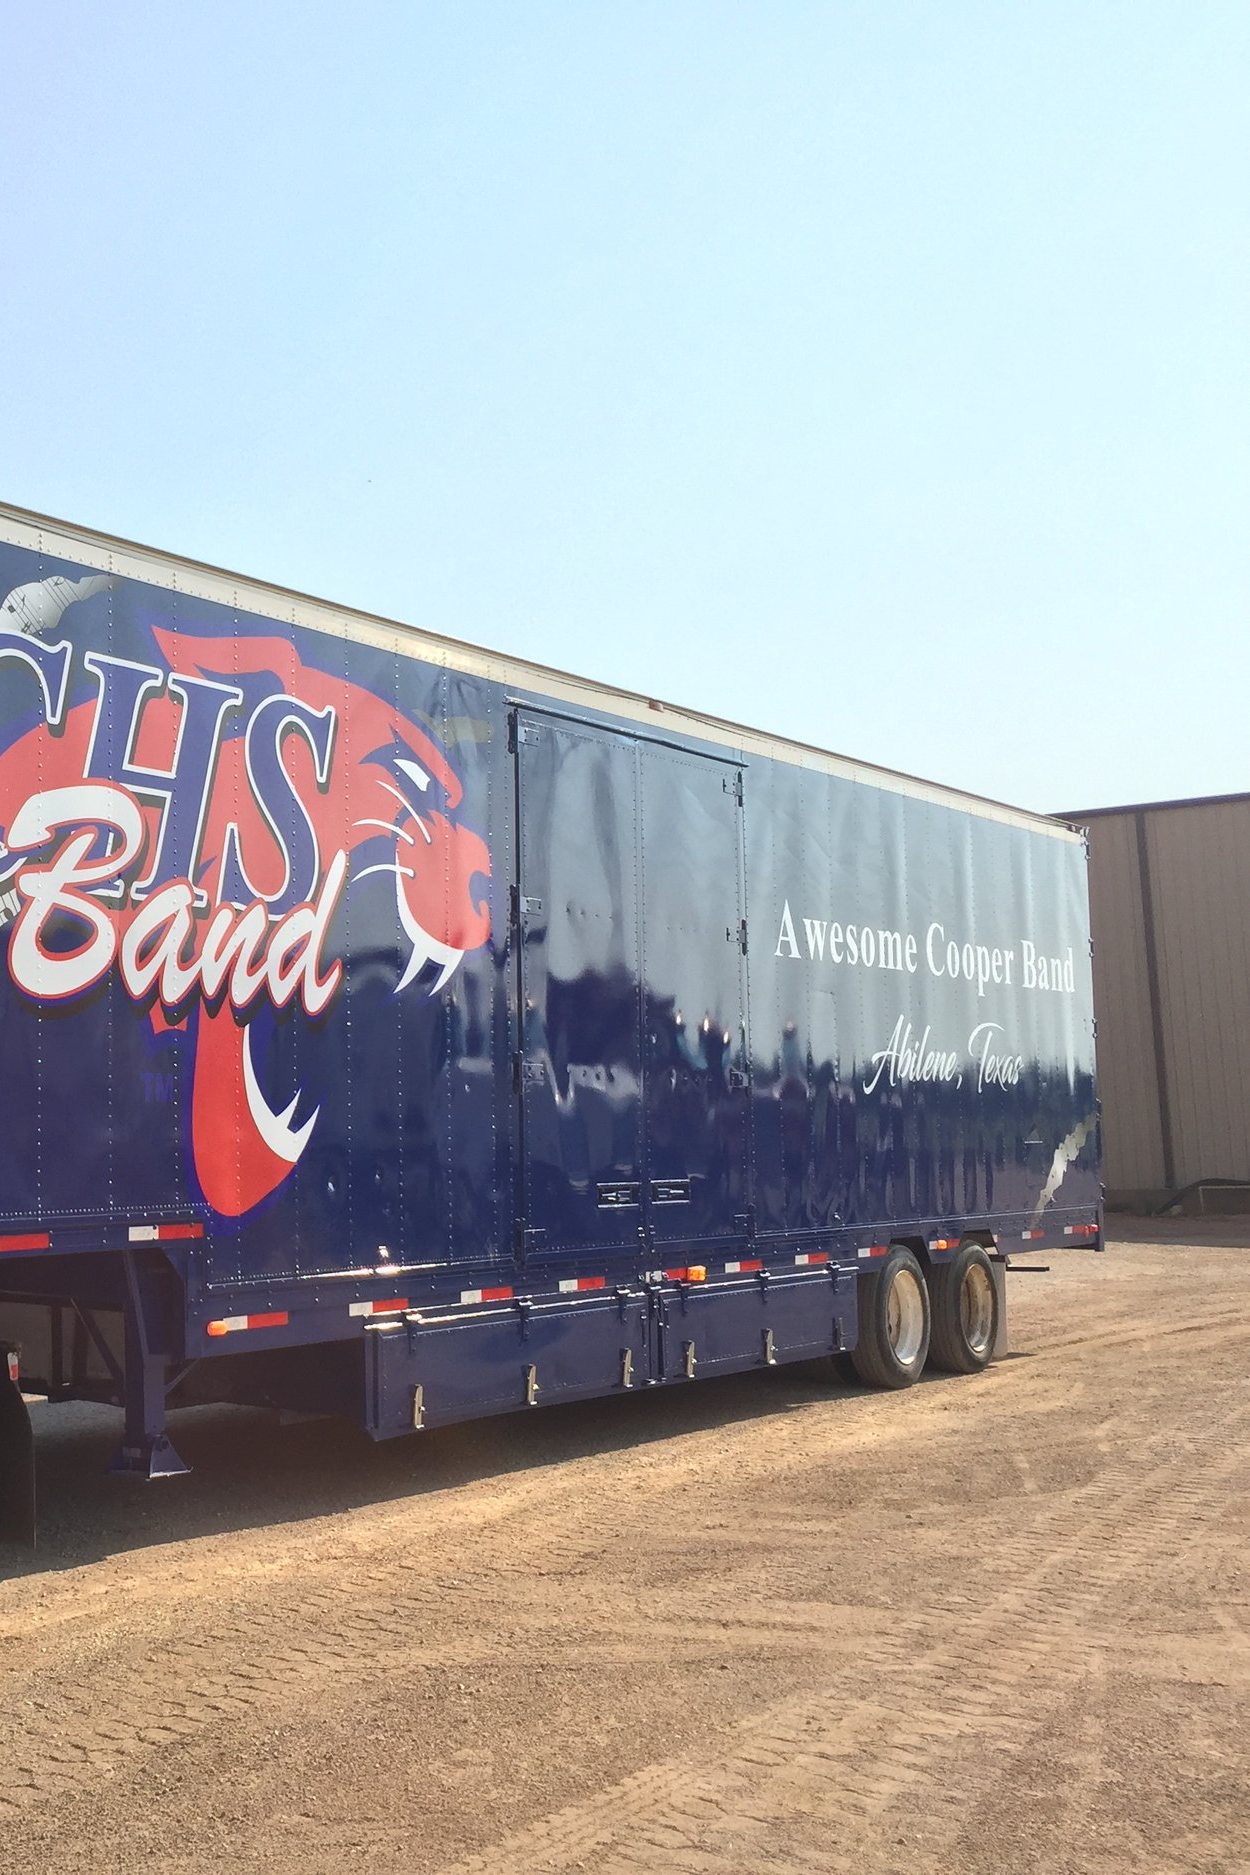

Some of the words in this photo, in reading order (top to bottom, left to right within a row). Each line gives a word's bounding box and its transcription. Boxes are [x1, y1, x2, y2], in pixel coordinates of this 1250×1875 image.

[7, 780, 350, 1013] Band
[774, 899, 917, 974] Awesome
[926, 922, 1014, 997] Cooper
[1021, 940, 1076, 993] Band
[862, 1014, 964, 1094] Abilene,
[968, 1022, 1024, 1094] Texas
